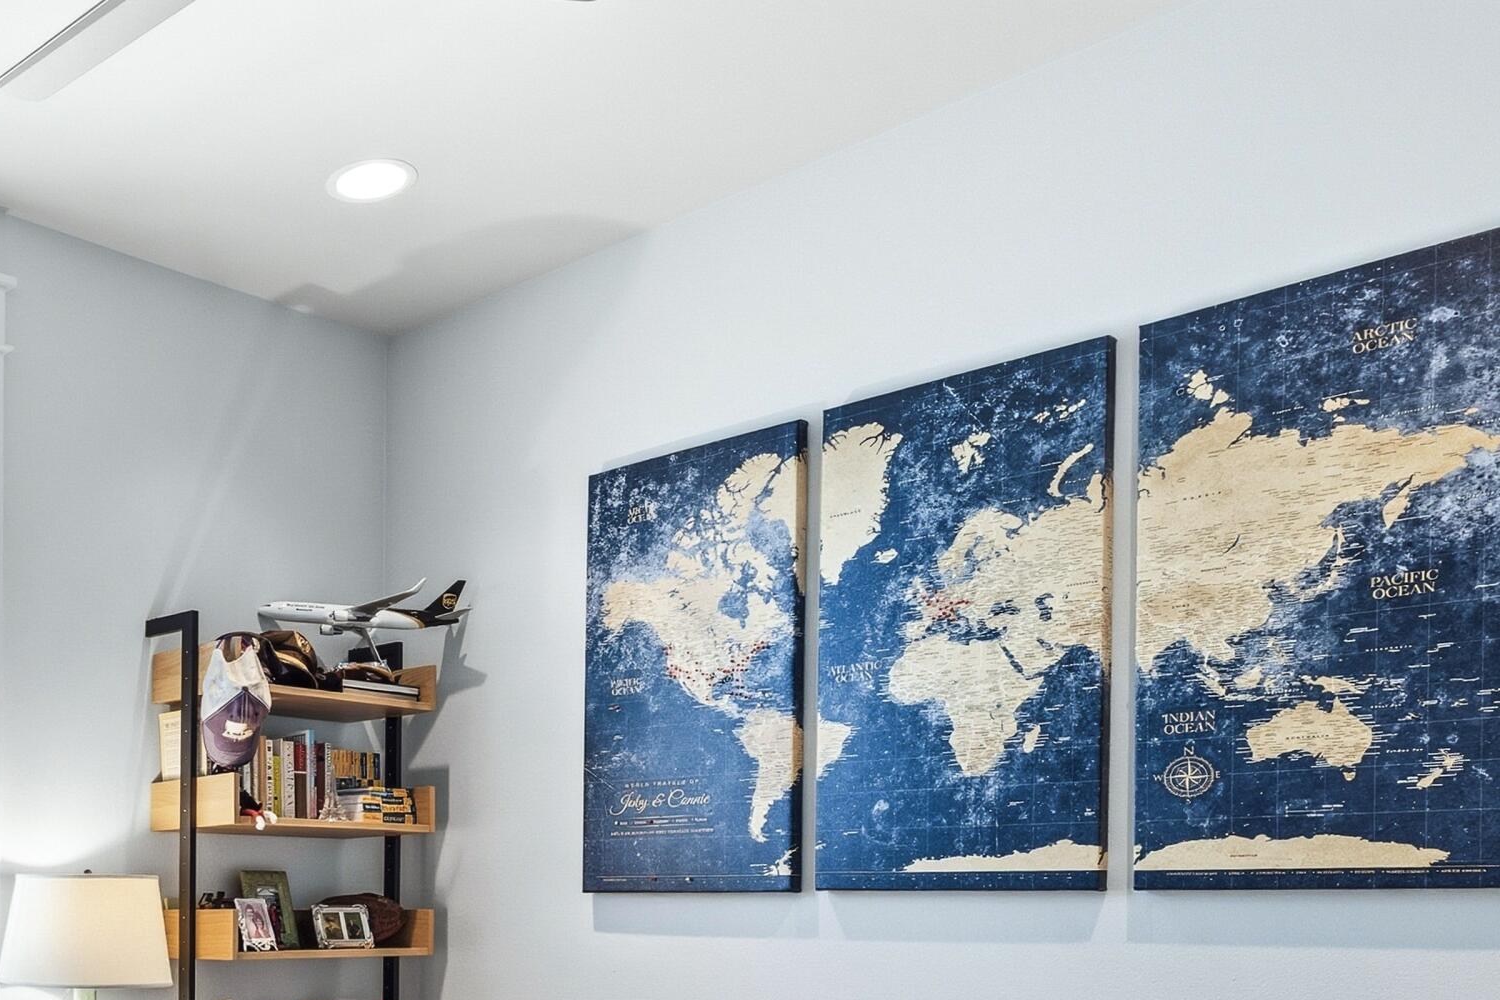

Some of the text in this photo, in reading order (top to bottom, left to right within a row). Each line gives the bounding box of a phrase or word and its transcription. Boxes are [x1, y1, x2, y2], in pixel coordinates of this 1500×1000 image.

[1351, 317, 1418, 343] ARCTIC
[1352, 332, 1416, 354] OCEAN
[1370, 568, 1440, 588] PACIFIC
[1372, 581, 1436, 600] OCEAN
[828, 660, 882, 679] ATLANTIC
[1161, 709, 1217, 725] INDIAN
[1163, 720, 1217, 736] OCEAN
[1182, 745, 1195, 758] N
[1152, 772, 1165, 782] W
[1214, 769, 1223, 779] E
[651, 793, 666, 808] &
